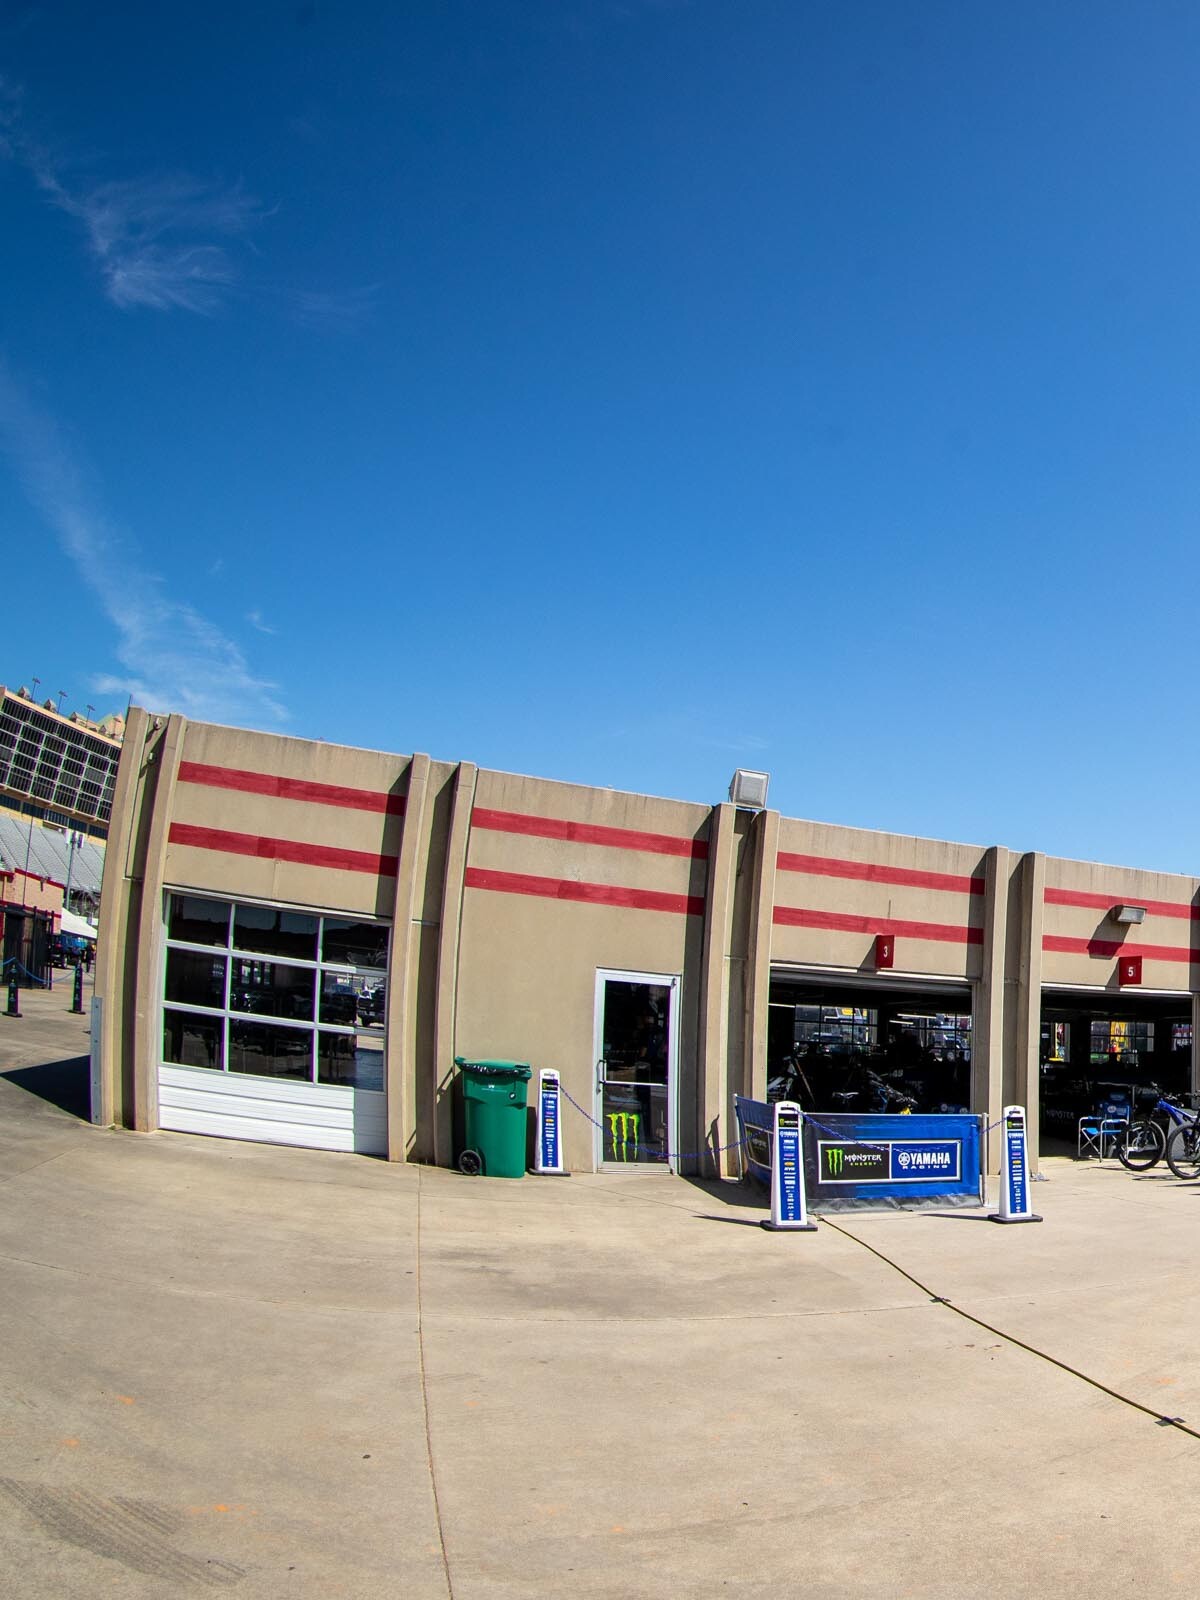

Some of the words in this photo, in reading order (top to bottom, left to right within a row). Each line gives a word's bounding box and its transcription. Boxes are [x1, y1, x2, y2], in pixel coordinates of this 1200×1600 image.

[883, 945, 889, 958] 3
[1127, 966, 1135, 977] 5
[844, 1153, 882, 1162] MONSTER
[910, 1152, 951, 1165] YAMAHA
